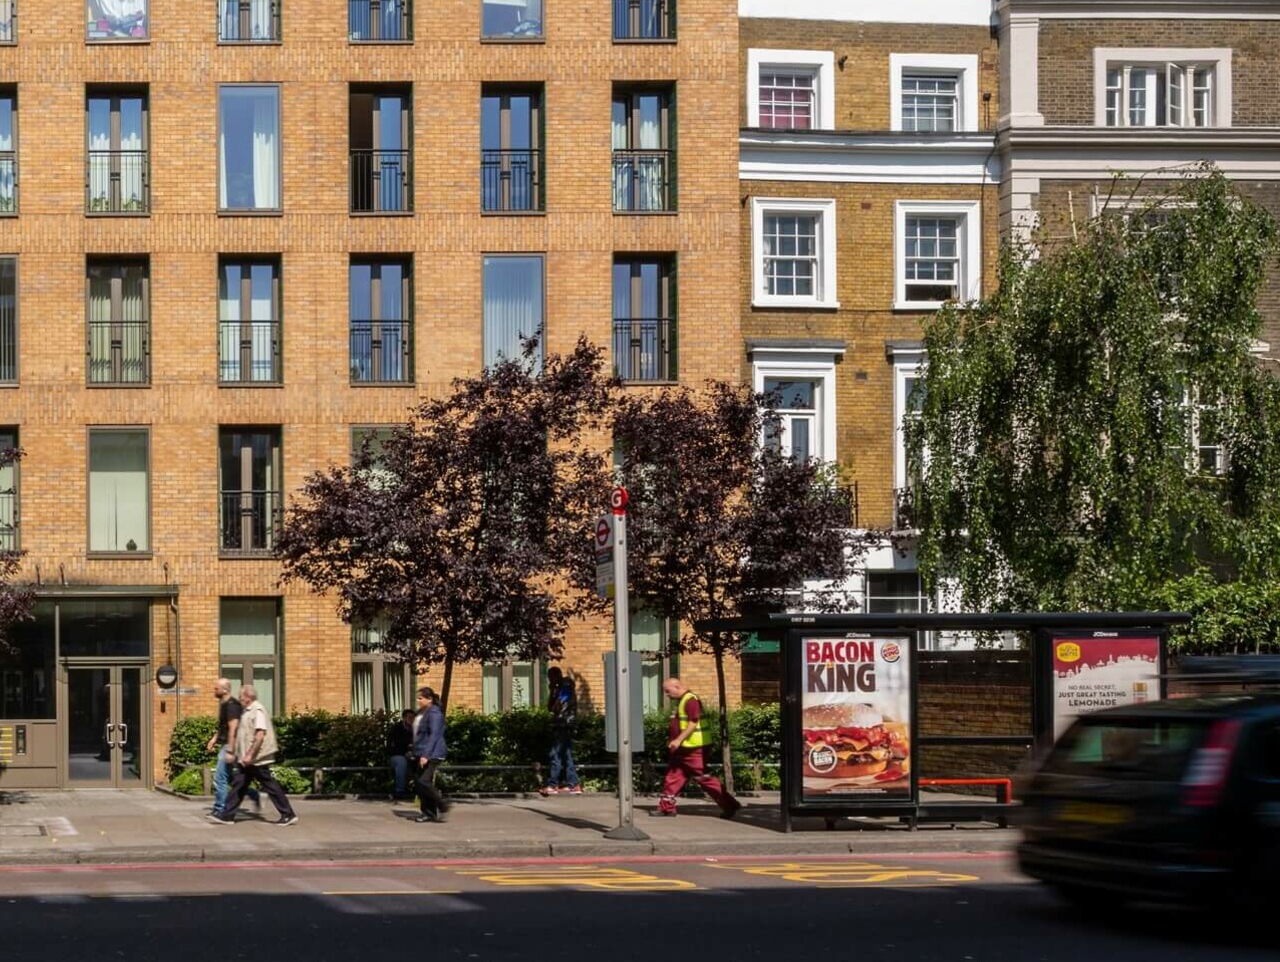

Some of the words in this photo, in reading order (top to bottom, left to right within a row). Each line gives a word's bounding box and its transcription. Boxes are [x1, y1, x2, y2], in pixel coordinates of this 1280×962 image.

[611, 489, 622, 507] G
[806, 641, 874, 663] BACON
[807, 663, 877, 693] KING
[1069, 699, 1117, 707] LEMONADE
